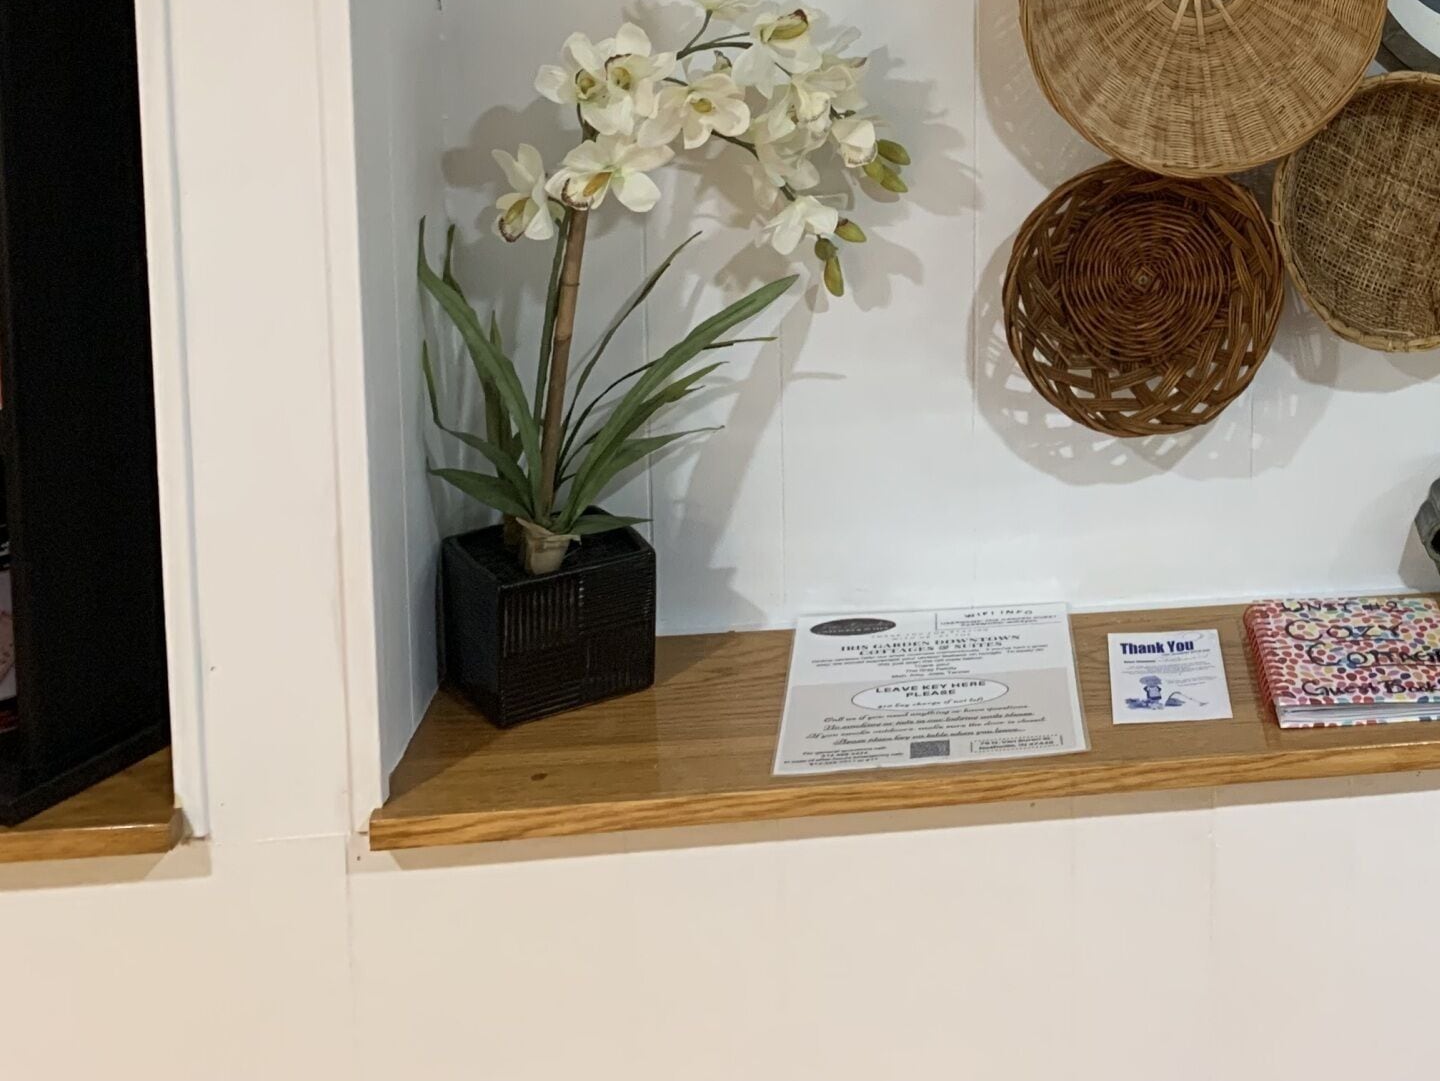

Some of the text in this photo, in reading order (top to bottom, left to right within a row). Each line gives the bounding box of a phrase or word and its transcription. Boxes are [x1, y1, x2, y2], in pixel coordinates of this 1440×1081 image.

[1120, 641, 1165, 655] Thank
[1167, 640, 1194, 653] You
[876, 684, 918, 693] LEAVE
[951, 680, 986, 688] HERE
[906, 689, 956, 698] PLEASE
